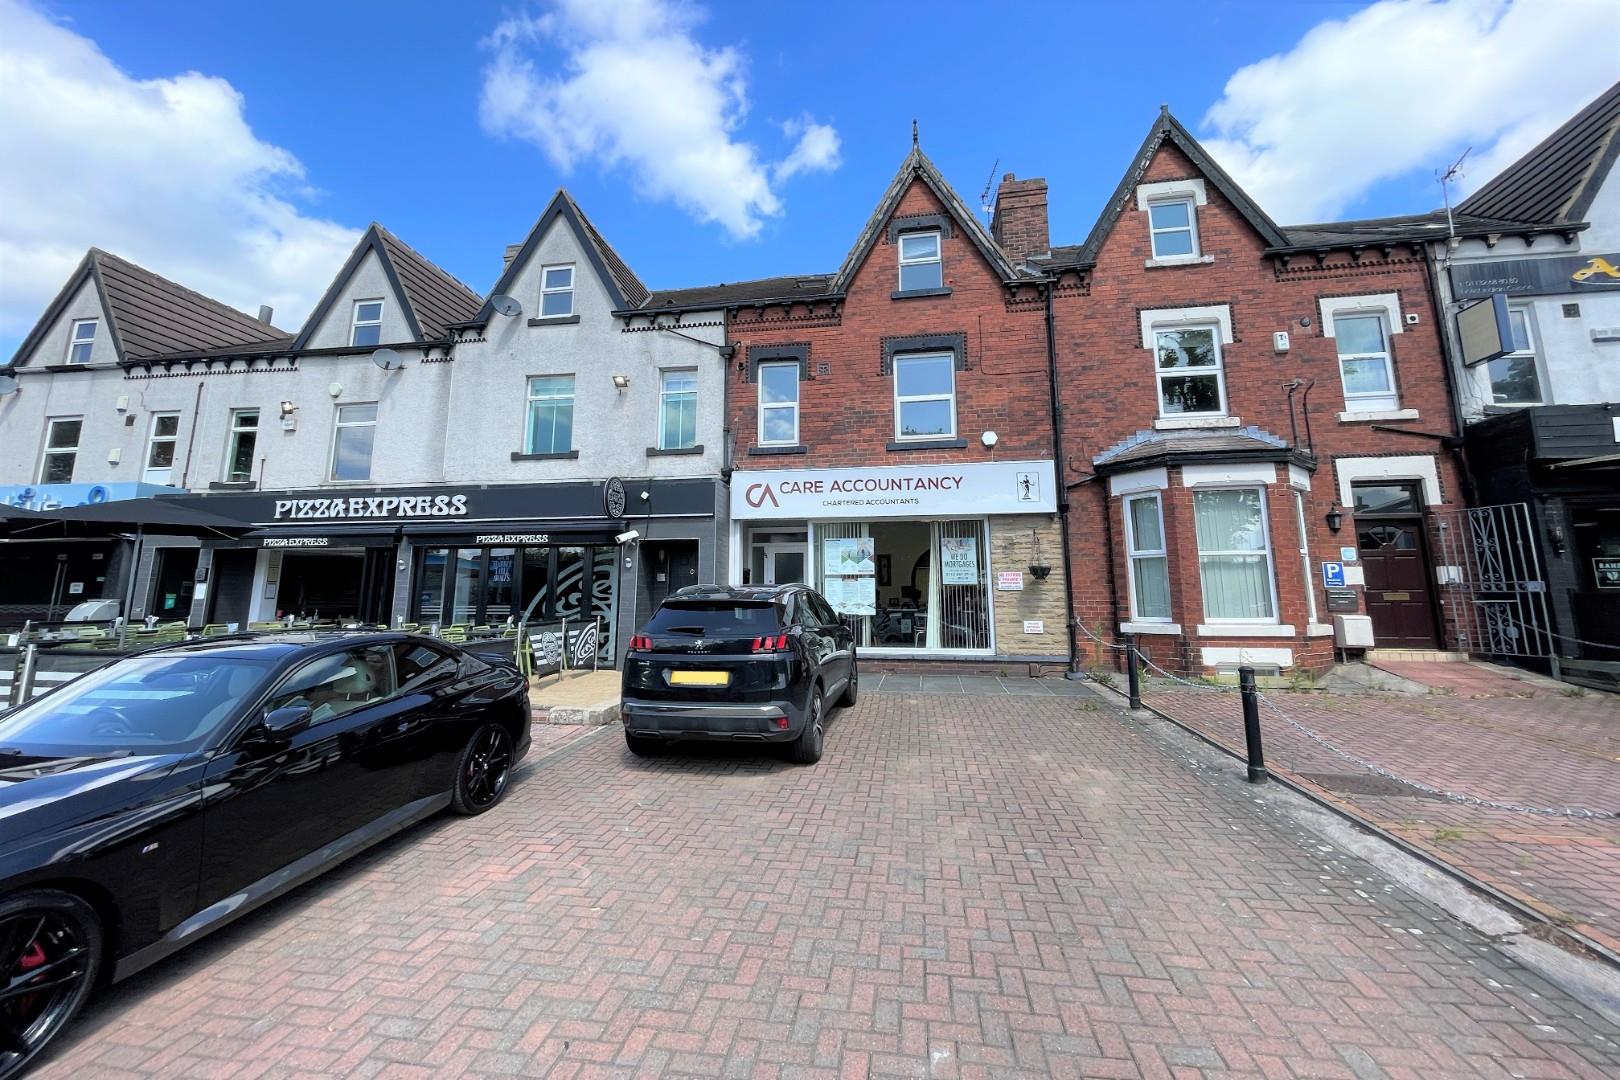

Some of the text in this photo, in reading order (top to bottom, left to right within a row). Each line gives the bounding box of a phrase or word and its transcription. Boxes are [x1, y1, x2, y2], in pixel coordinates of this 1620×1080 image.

[780, 476, 964, 494] CARE ACCOUNTANCY
[822, 497, 919, 507] CHARTERED ACCOUNTANTS
[1326, 563, 1340, 579] P
